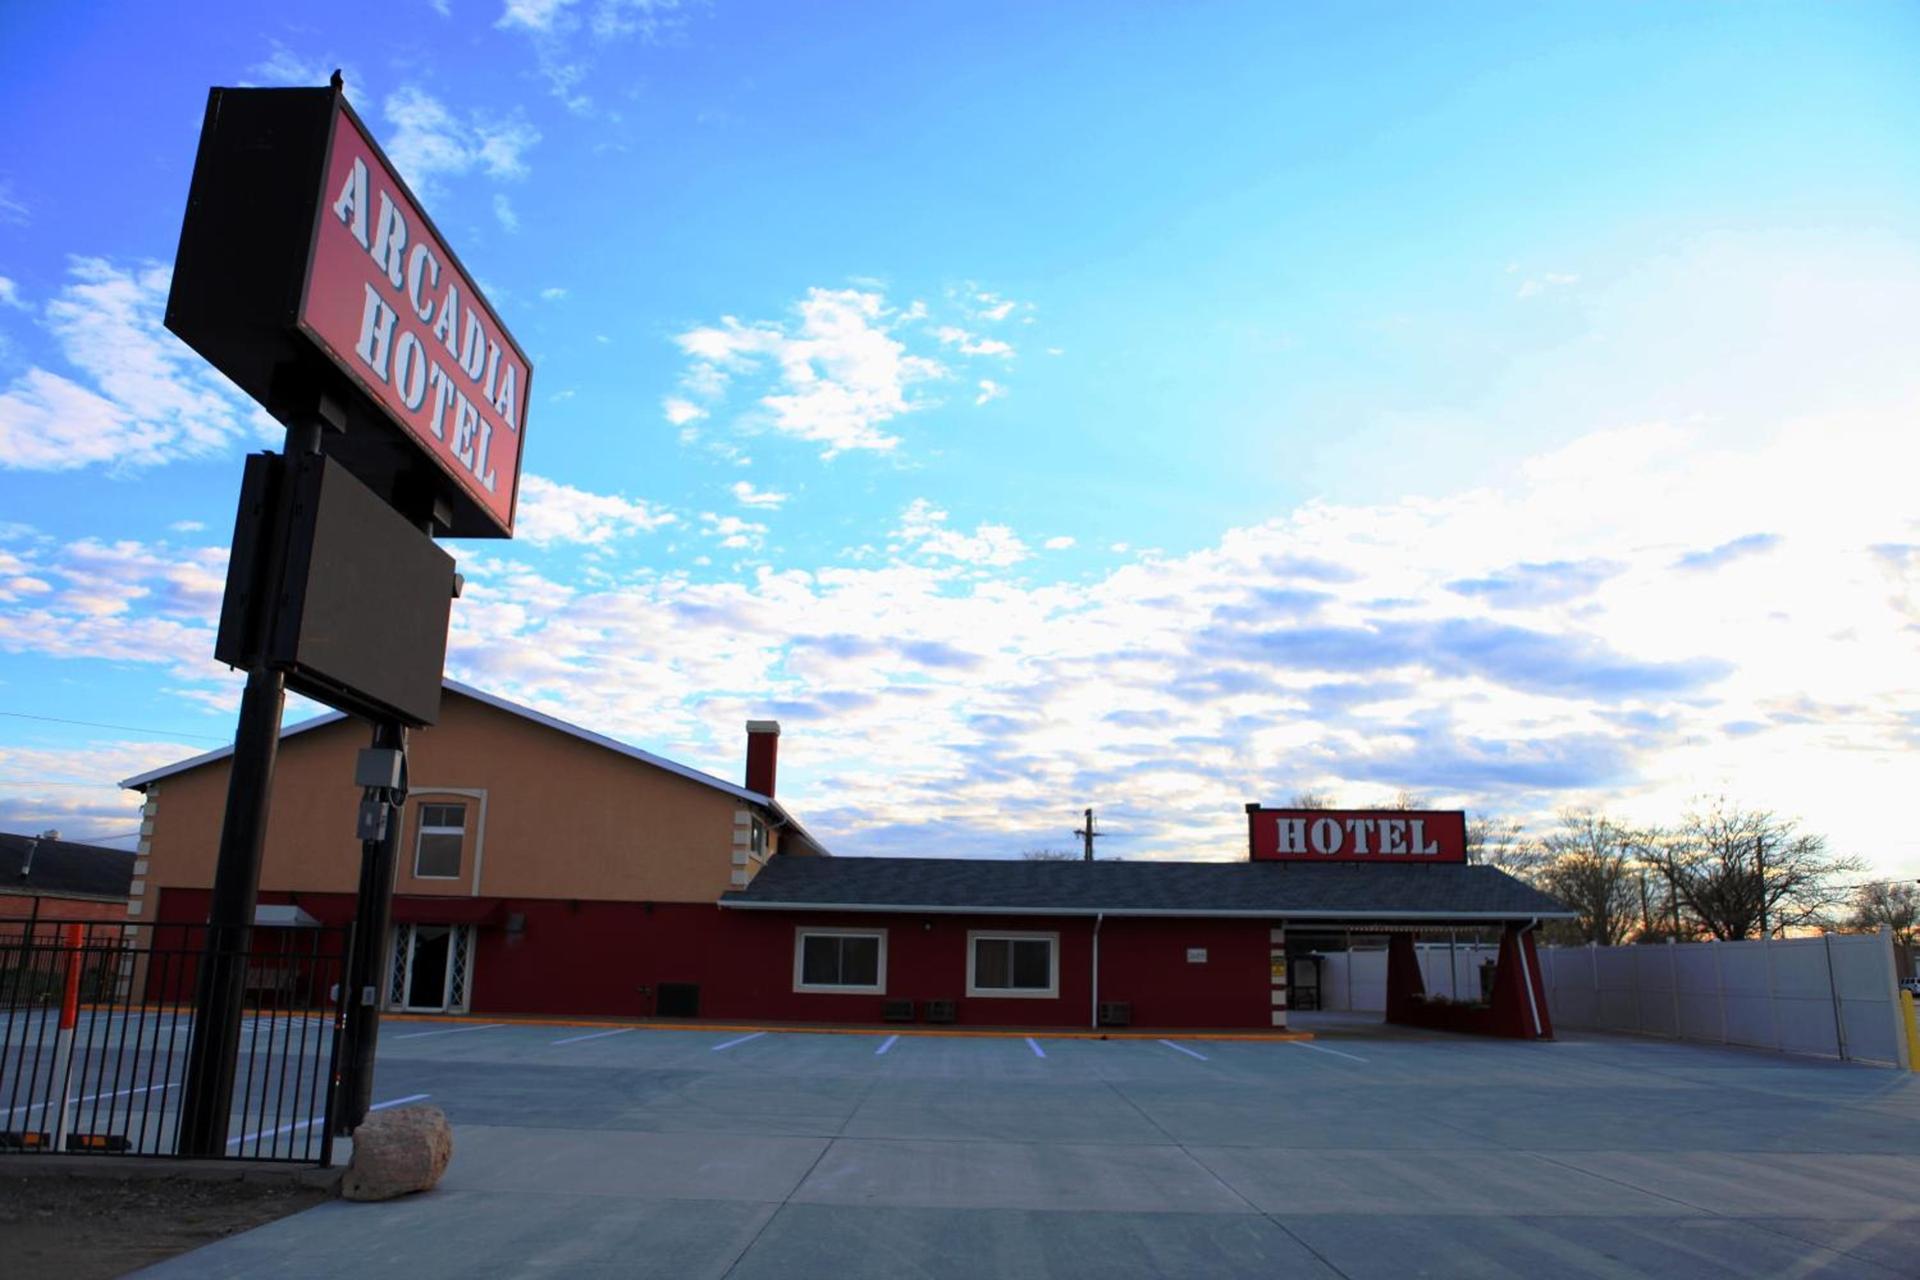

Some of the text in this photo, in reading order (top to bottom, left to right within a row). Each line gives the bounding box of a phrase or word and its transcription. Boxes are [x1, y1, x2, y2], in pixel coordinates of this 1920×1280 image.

[333, 155, 517, 432] ARCADIA
[355, 282, 497, 494] HOTEL
[1276, 817, 1439, 855] HOTEL
